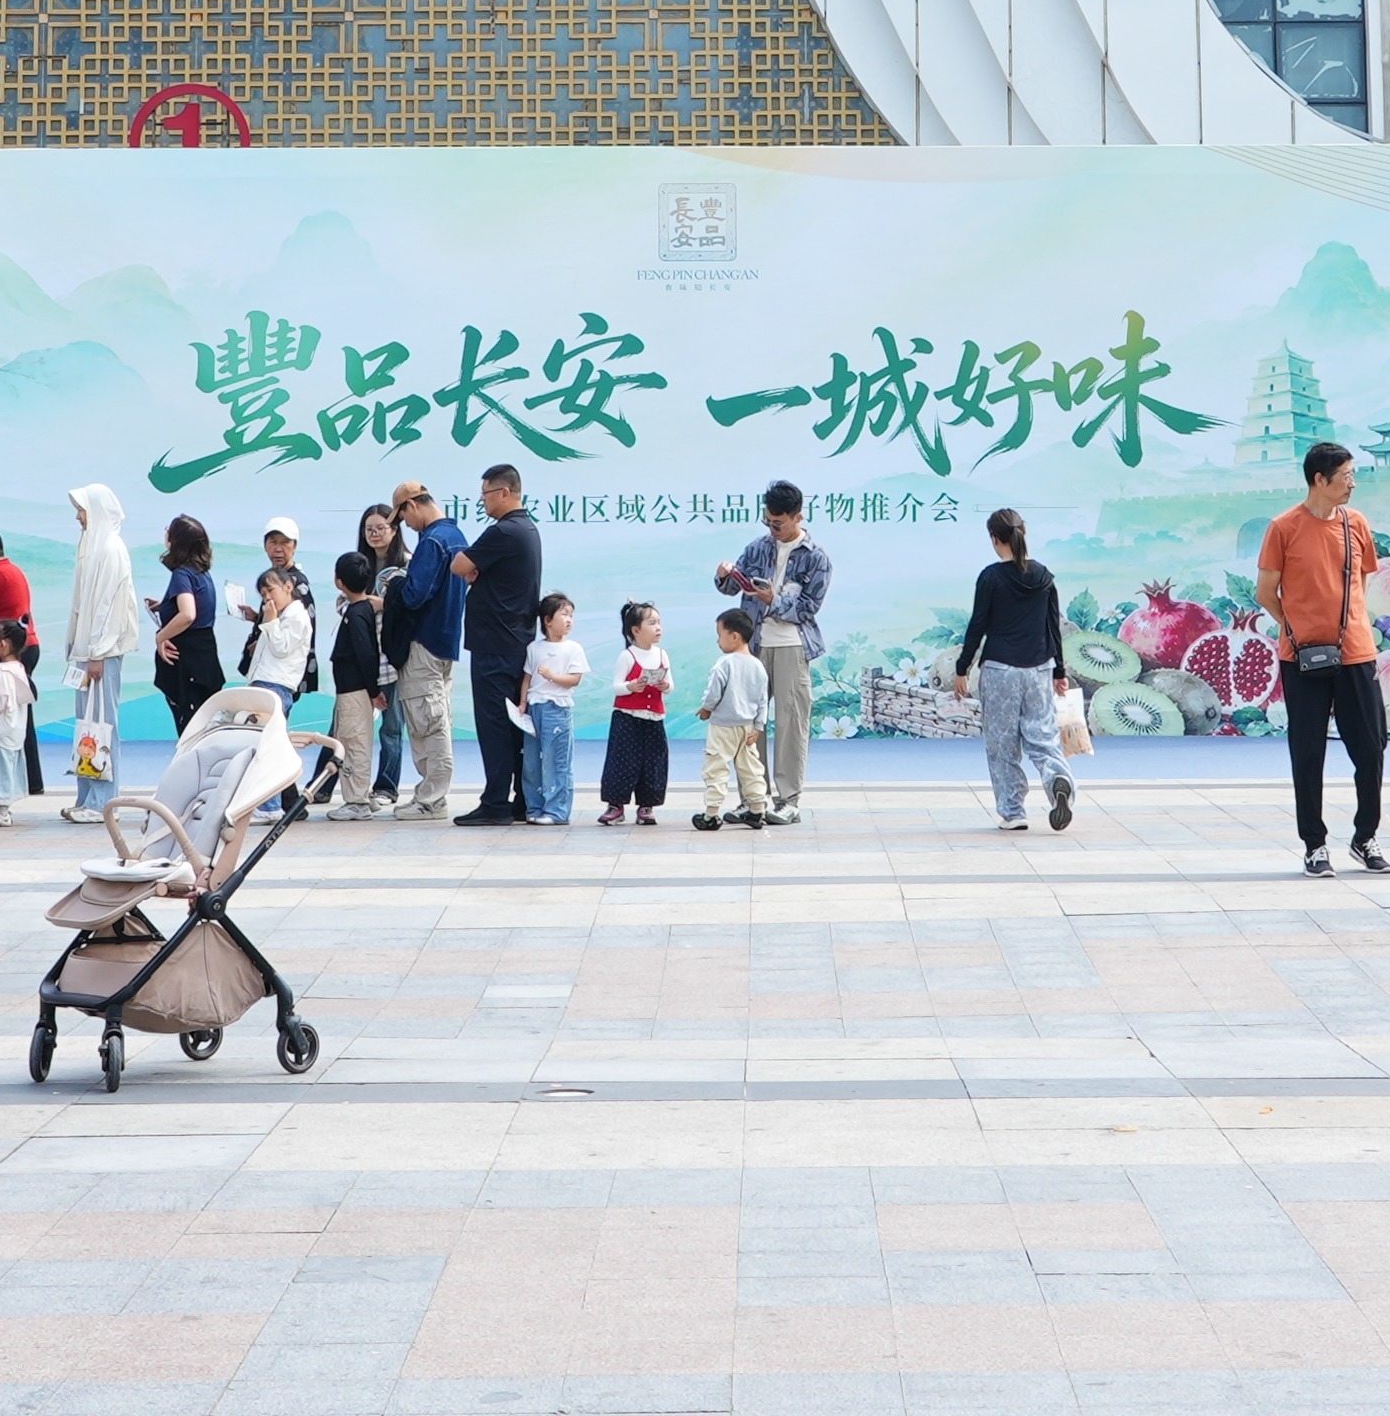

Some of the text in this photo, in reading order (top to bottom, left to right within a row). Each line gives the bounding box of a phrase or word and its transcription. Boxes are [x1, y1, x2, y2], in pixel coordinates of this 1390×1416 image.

[147, 309, 1239, 495] 豐品长安 一城好味
